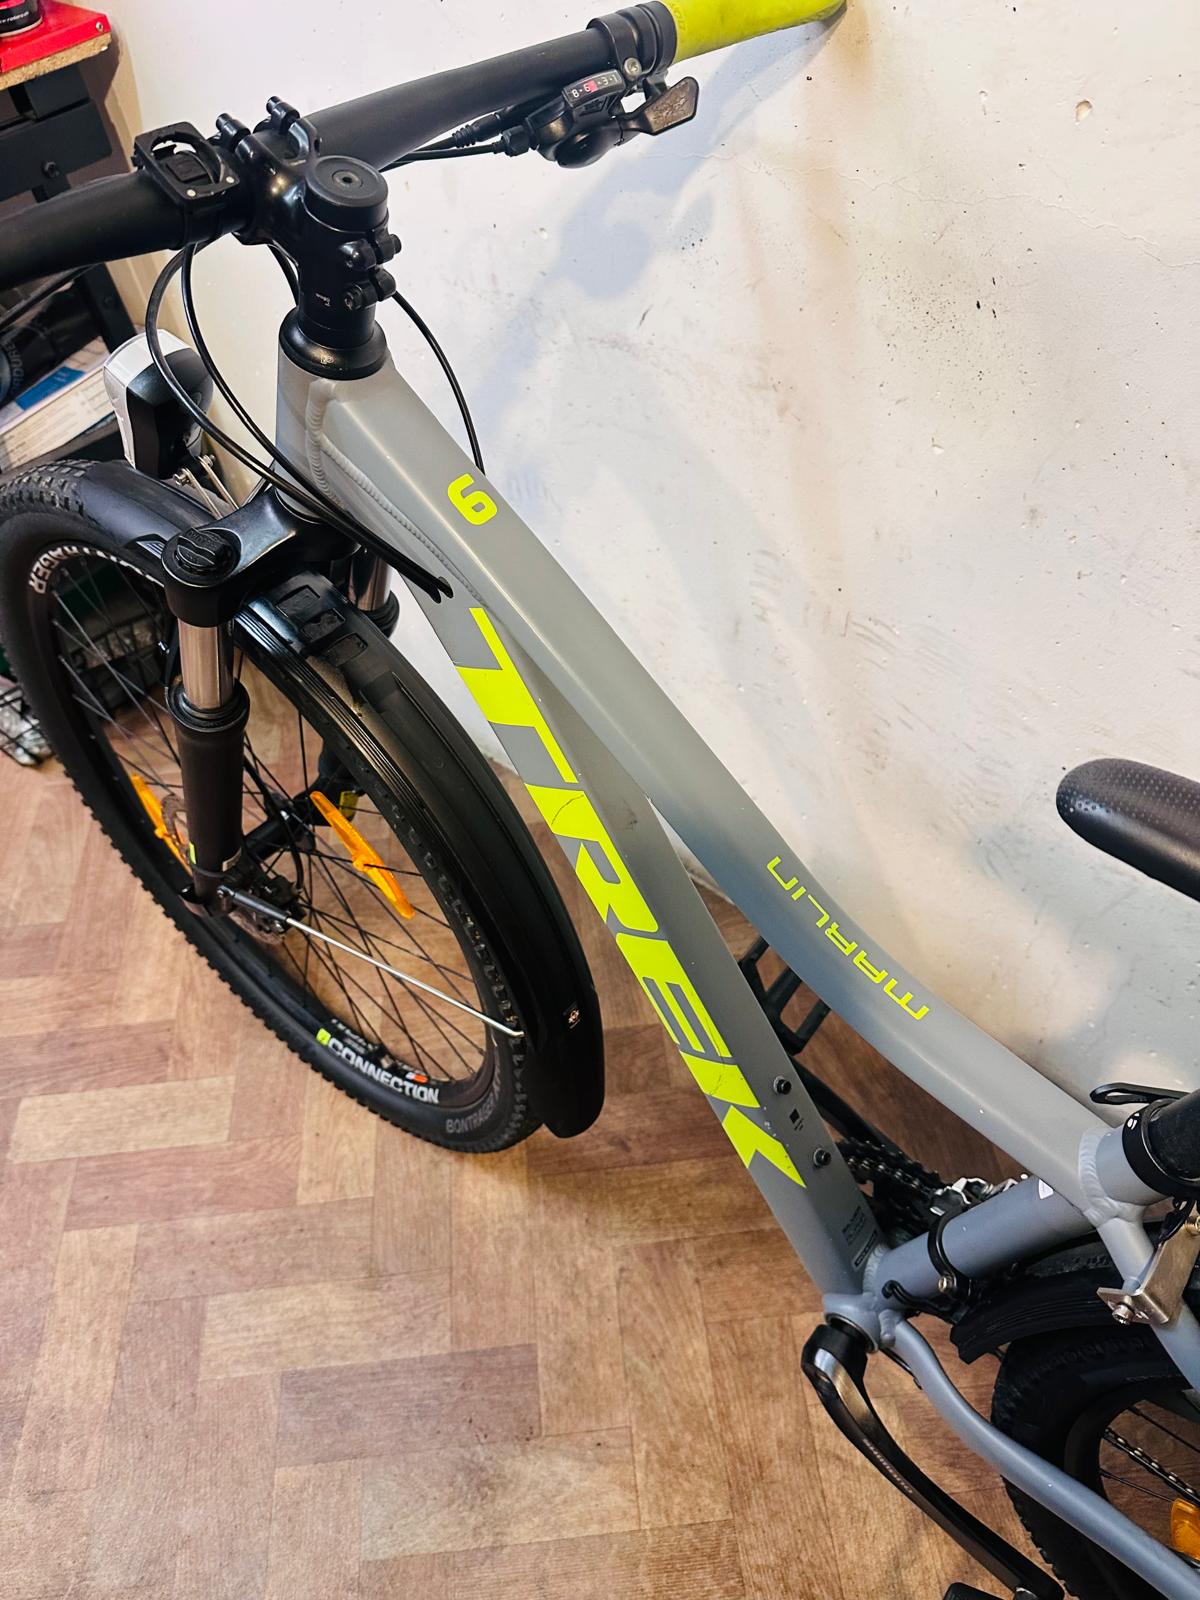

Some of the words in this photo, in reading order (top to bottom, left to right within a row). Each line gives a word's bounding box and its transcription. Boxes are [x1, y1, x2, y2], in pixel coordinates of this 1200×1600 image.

[447, 473, 498, 525] 6
[456, 607, 807, 1188] TREK
[767, 856, 930, 1020] MARLIN
[327, 1037, 440, 1104] CONNECTION
